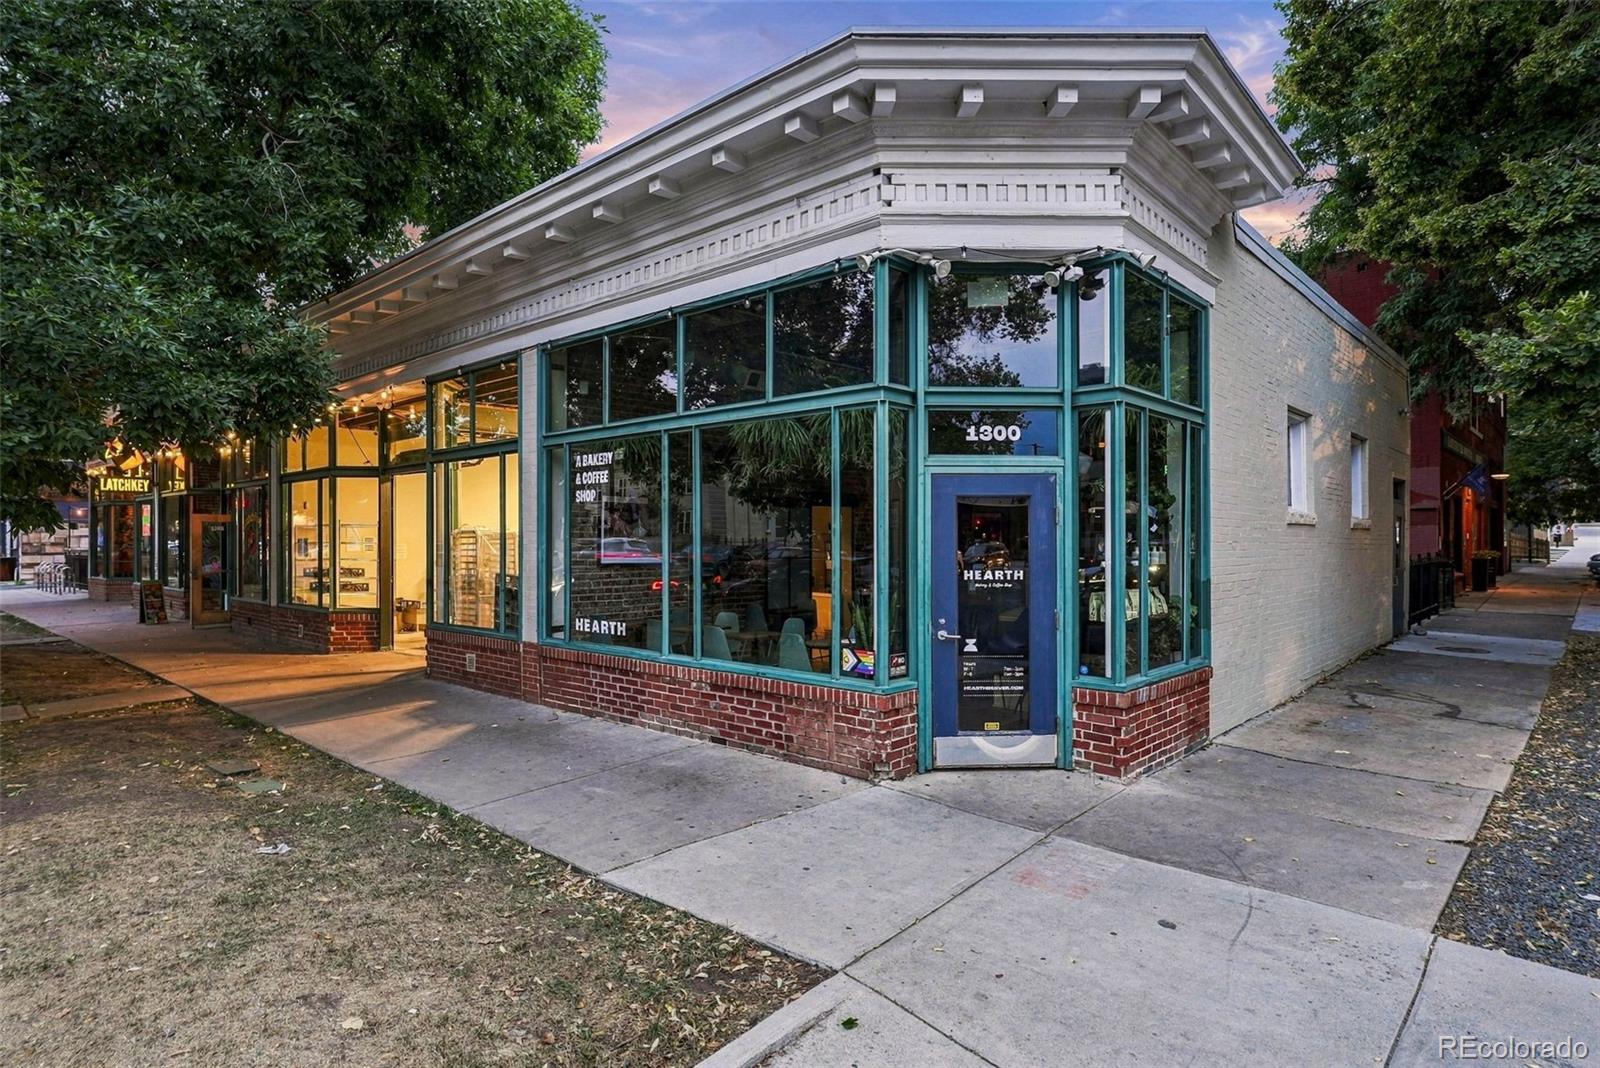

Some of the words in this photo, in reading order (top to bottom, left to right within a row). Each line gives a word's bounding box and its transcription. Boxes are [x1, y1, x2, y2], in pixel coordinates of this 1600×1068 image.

[965, 425, 1021, 442] 1300
[575, 455, 582, 468] A
[582, 451, 613, 467] BAKERY
[100, 478, 150, 492] LATCHKEY
[575, 472, 582, 485] &
[582, 470, 609, 484] COFFEE
[575, 489, 597, 503] SHOP
[963, 569, 1024, 581] HEARTH
[575, 617, 627, 636] HEARTH
